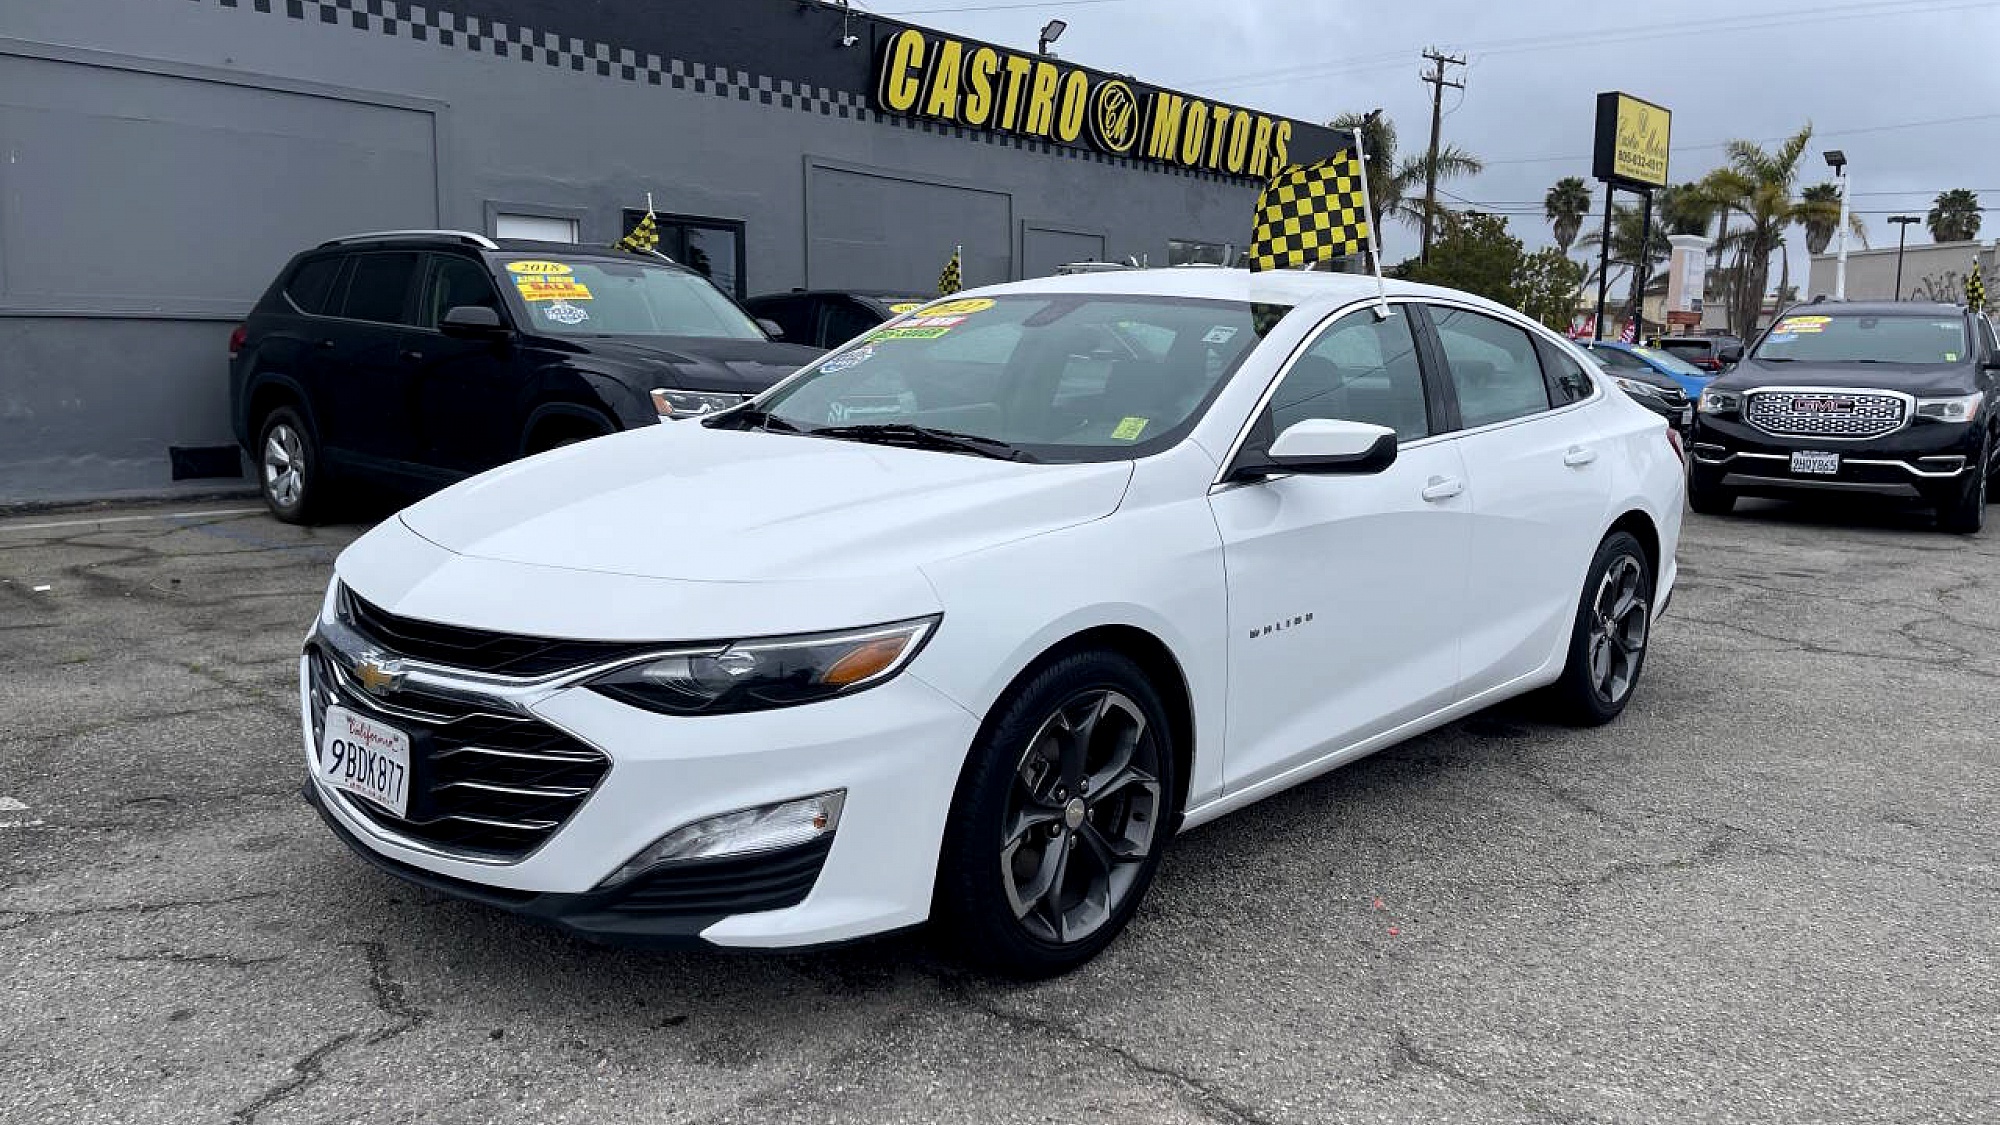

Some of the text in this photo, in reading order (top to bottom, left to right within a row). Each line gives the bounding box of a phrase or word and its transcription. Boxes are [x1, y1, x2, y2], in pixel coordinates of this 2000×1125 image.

[887, 29, 1088, 142] CASTRO
[1149, 92, 1292, 176] MOTORS
[531, 282, 575, 291] SALE
[1795, 400, 1852, 411] GMC
[328, 739, 405, 803] 9BDK877
